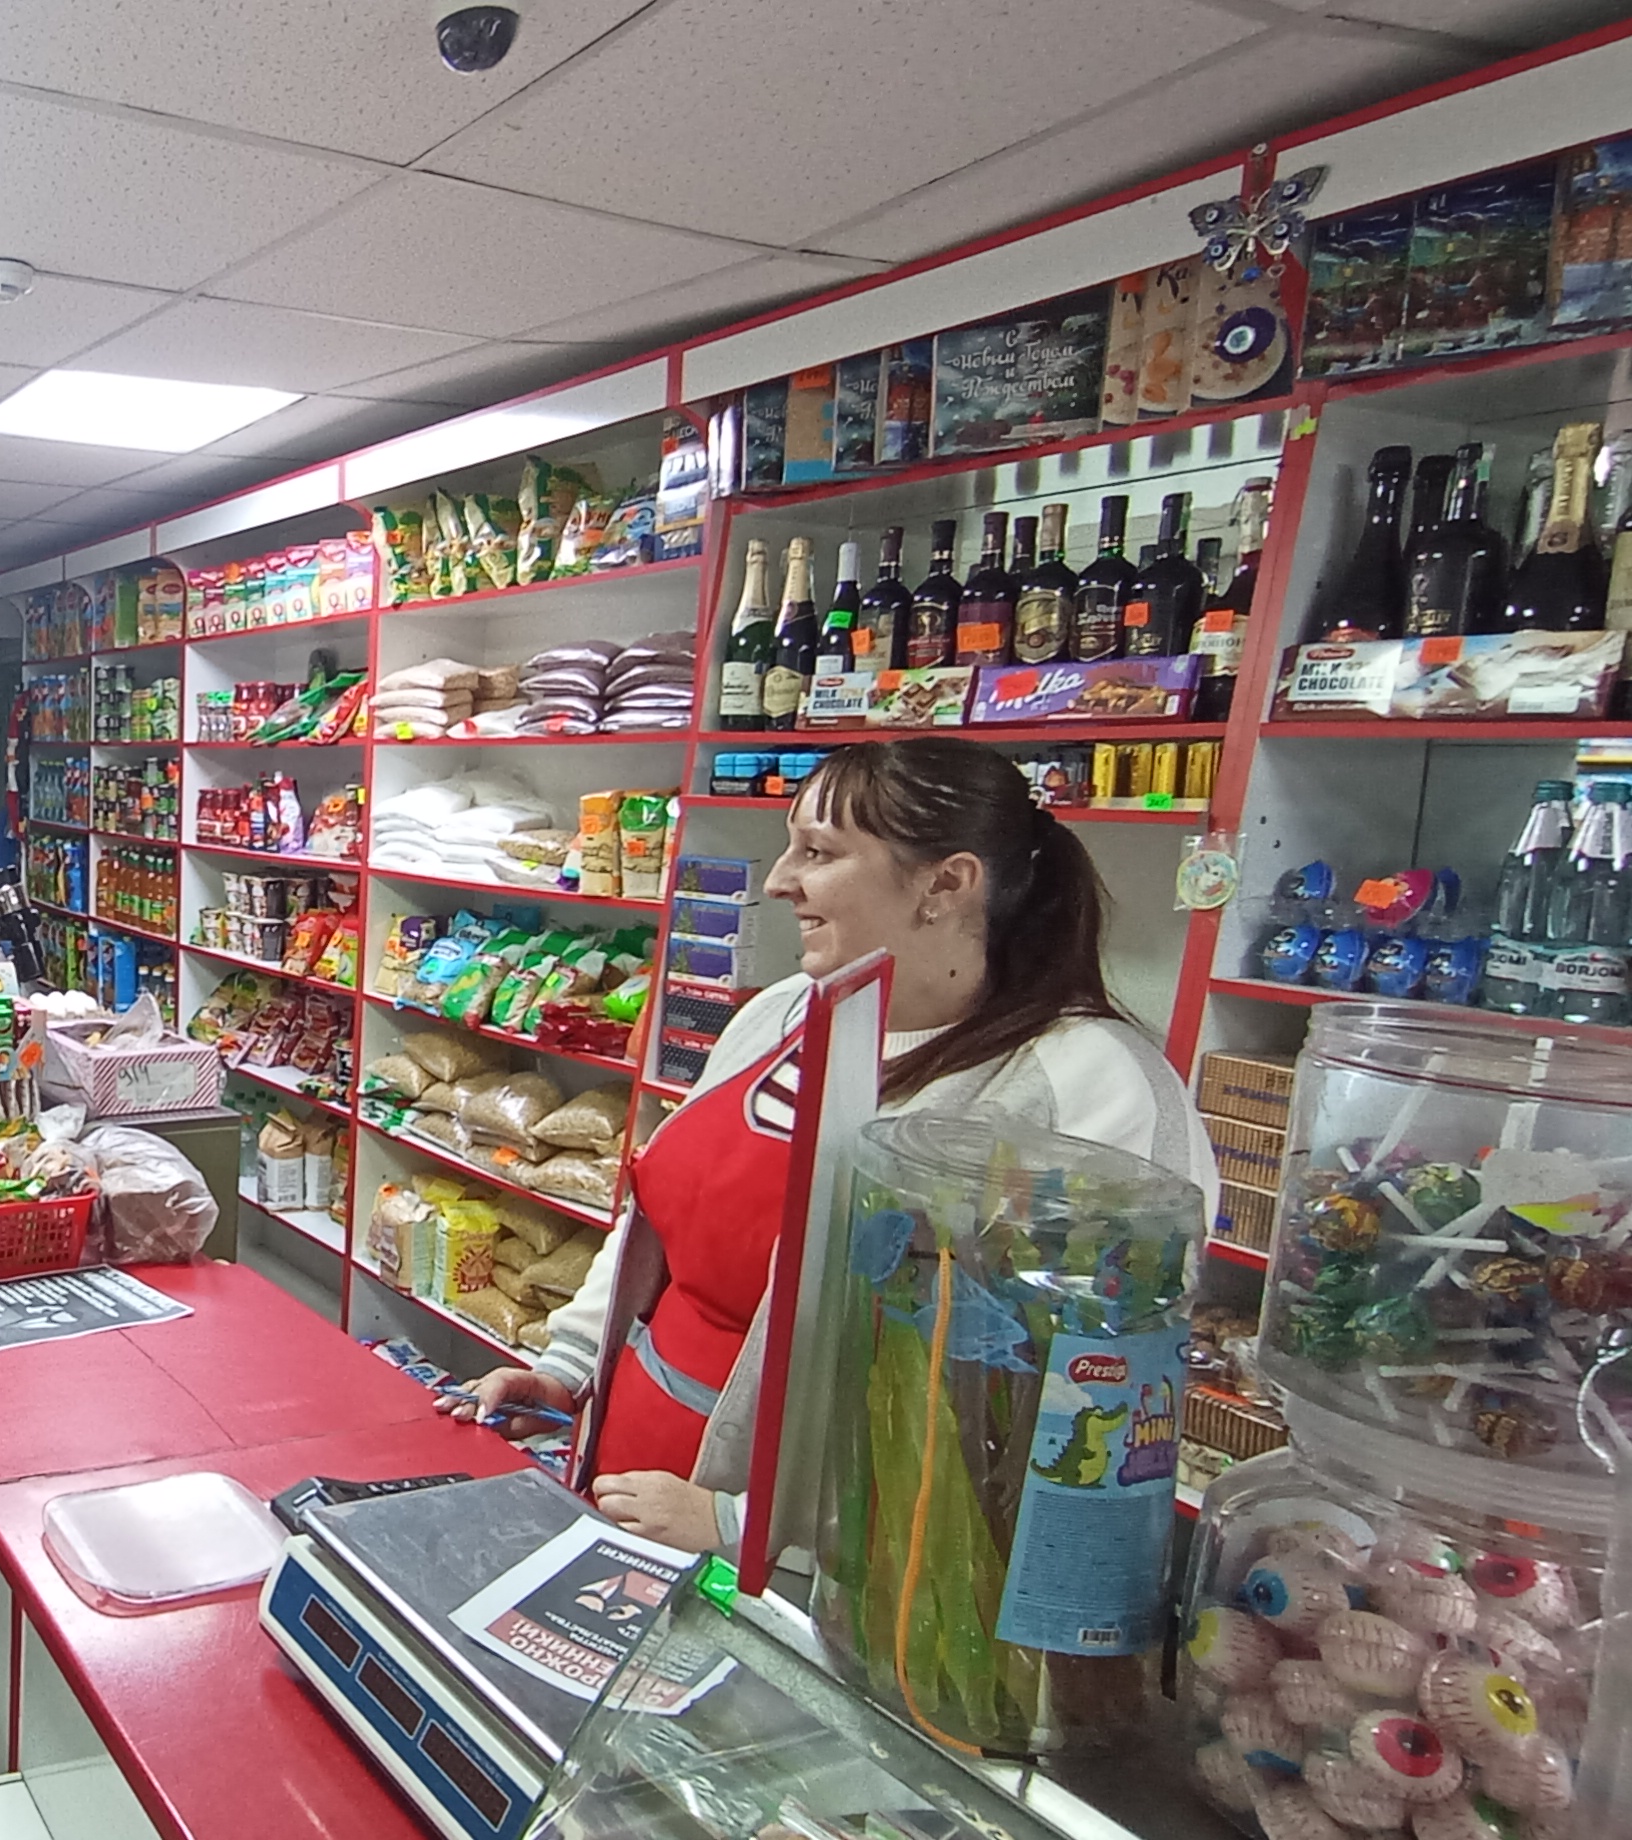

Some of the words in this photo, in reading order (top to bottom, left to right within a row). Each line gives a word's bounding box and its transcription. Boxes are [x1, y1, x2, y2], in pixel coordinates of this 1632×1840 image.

[1297, 676, 1385, 691] CHOCOLATE
[812, 698, 863, 709] CHOCOLATE
[596, 1543, 681, 1582] ЕННИКИ!
